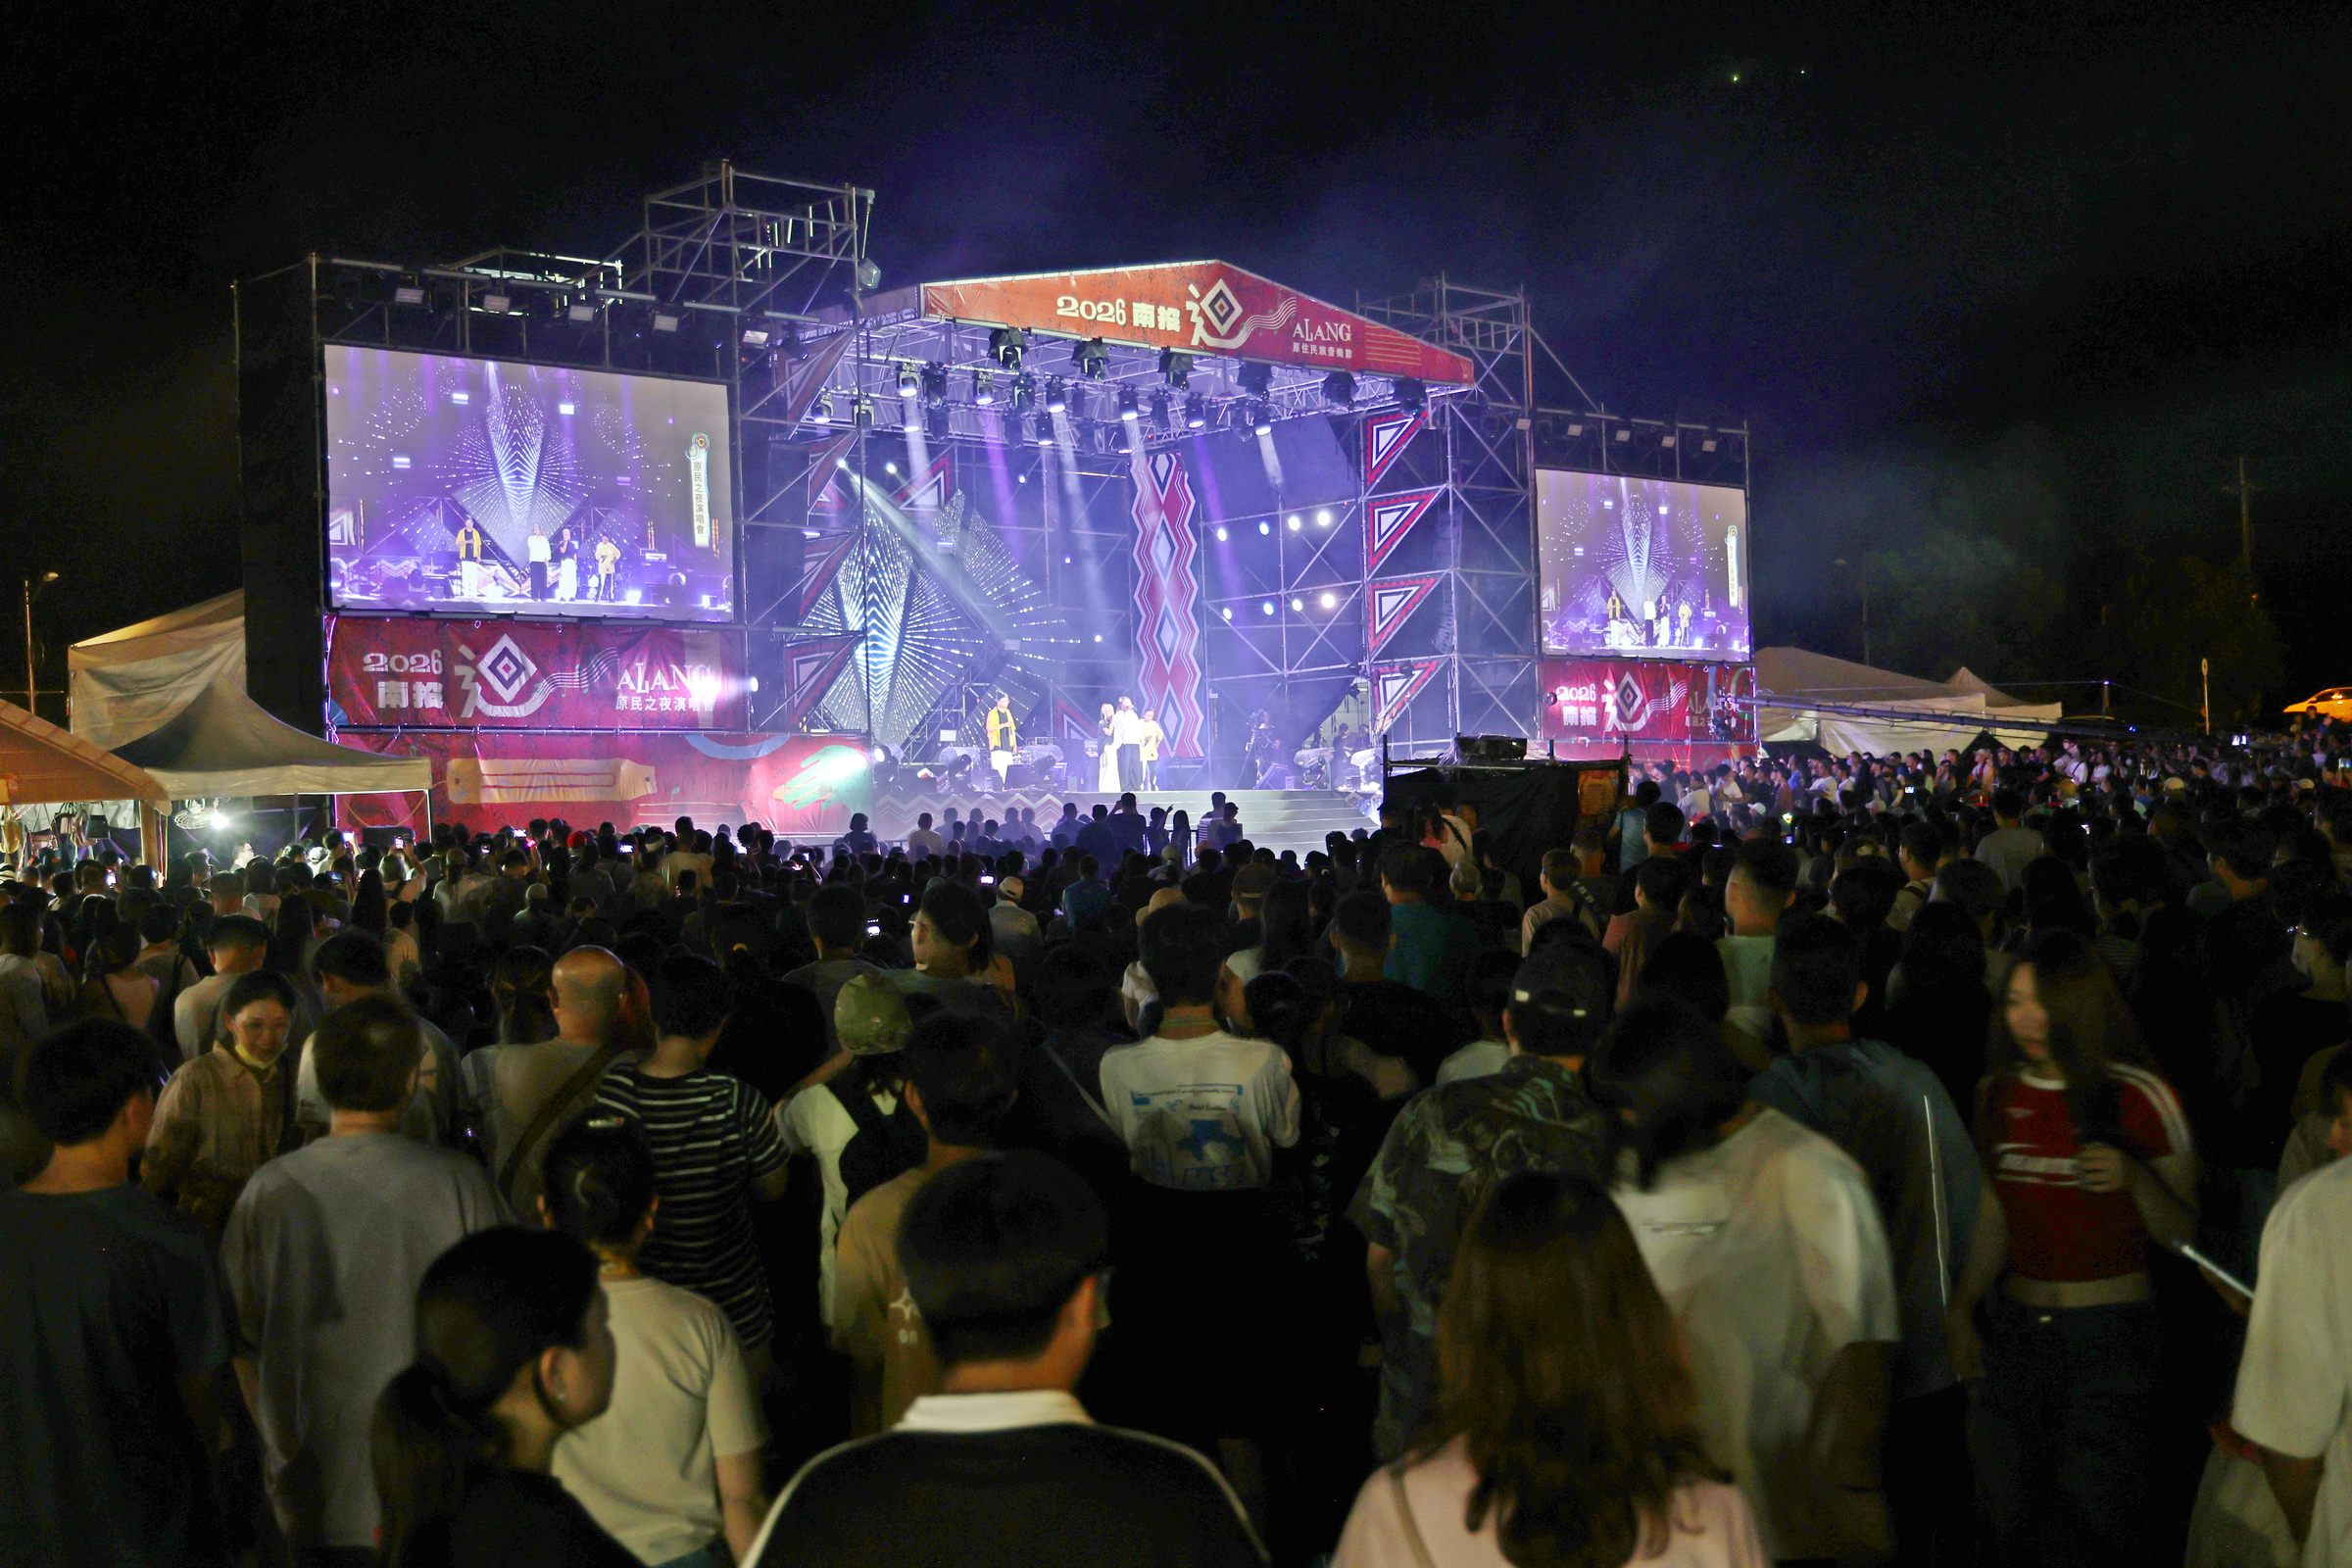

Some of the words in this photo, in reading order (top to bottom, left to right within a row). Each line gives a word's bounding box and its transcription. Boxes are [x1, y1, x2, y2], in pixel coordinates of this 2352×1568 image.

[1056, 296, 1127, 325] 2026
[1132, 302, 1181, 332] 南投
[1293, 318, 1351, 341] ALANG
[694, 462, 705, 534] 原民之夜演唱會
[363, 649, 443, 674] 2026
[377, 681, 444, 709] 南投
[1556, 683, 1596, 702] 2026
